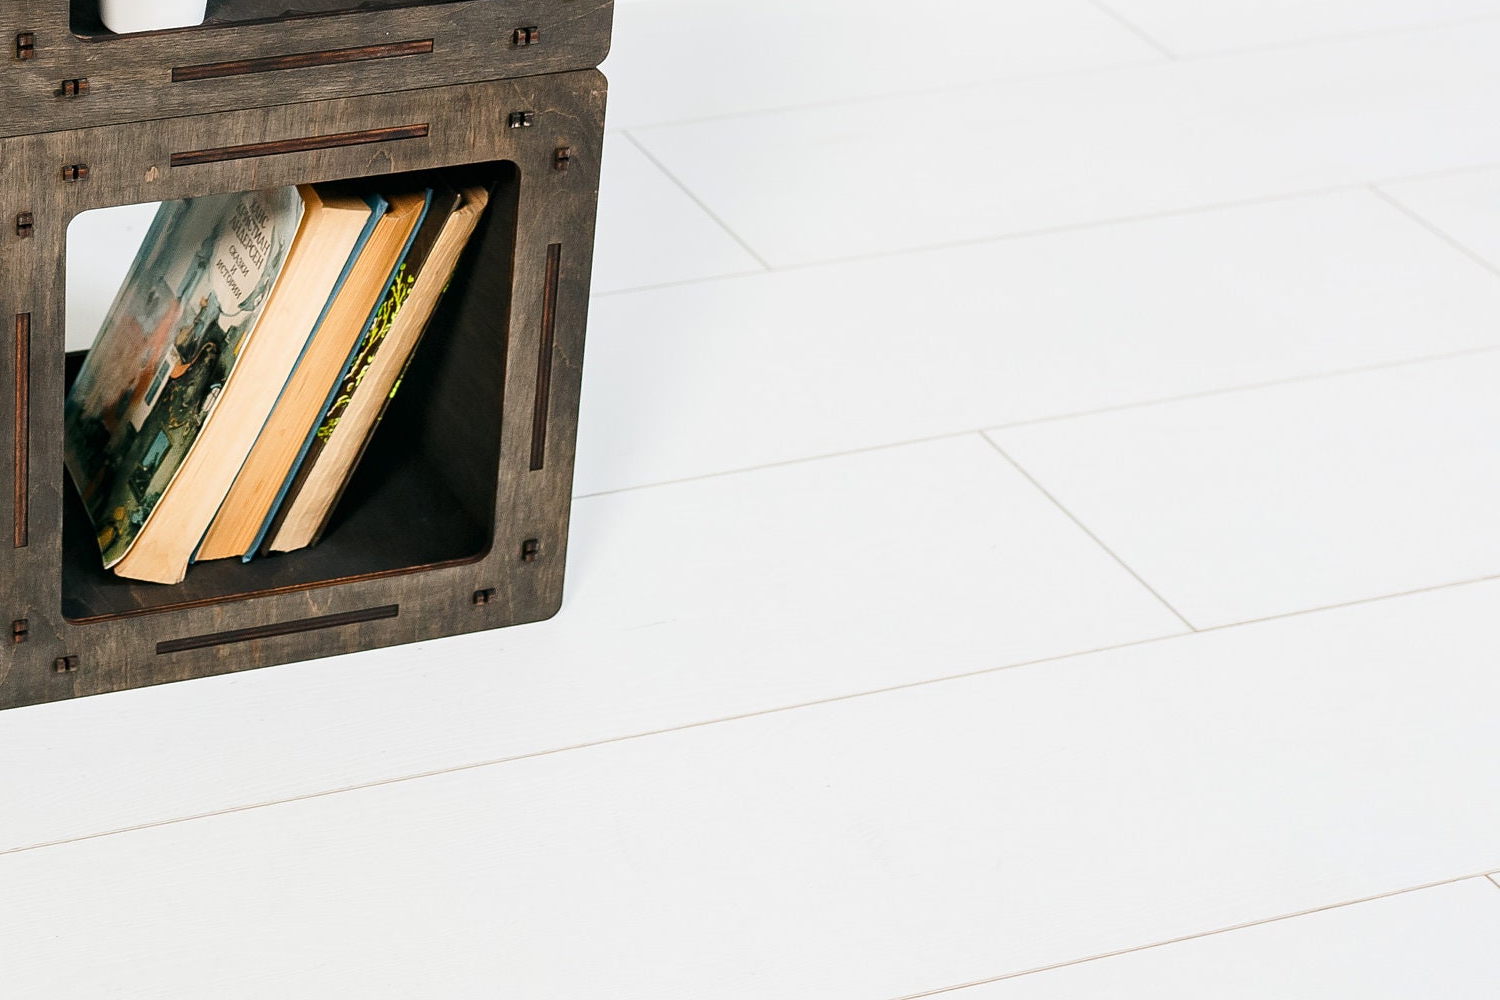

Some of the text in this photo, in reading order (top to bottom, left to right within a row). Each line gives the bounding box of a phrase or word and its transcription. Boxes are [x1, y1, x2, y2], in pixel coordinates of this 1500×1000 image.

[236, 199, 271, 256] КРИСТИАН
[248, 198, 269, 228] ХАНС
[229, 215, 264, 270] АНДЕРСЕН
[216, 259, 242, 299] ИСТОРИИ
[229, 245, 250, 278] СКАЗКИ
[230, 264, 238, 275] И
